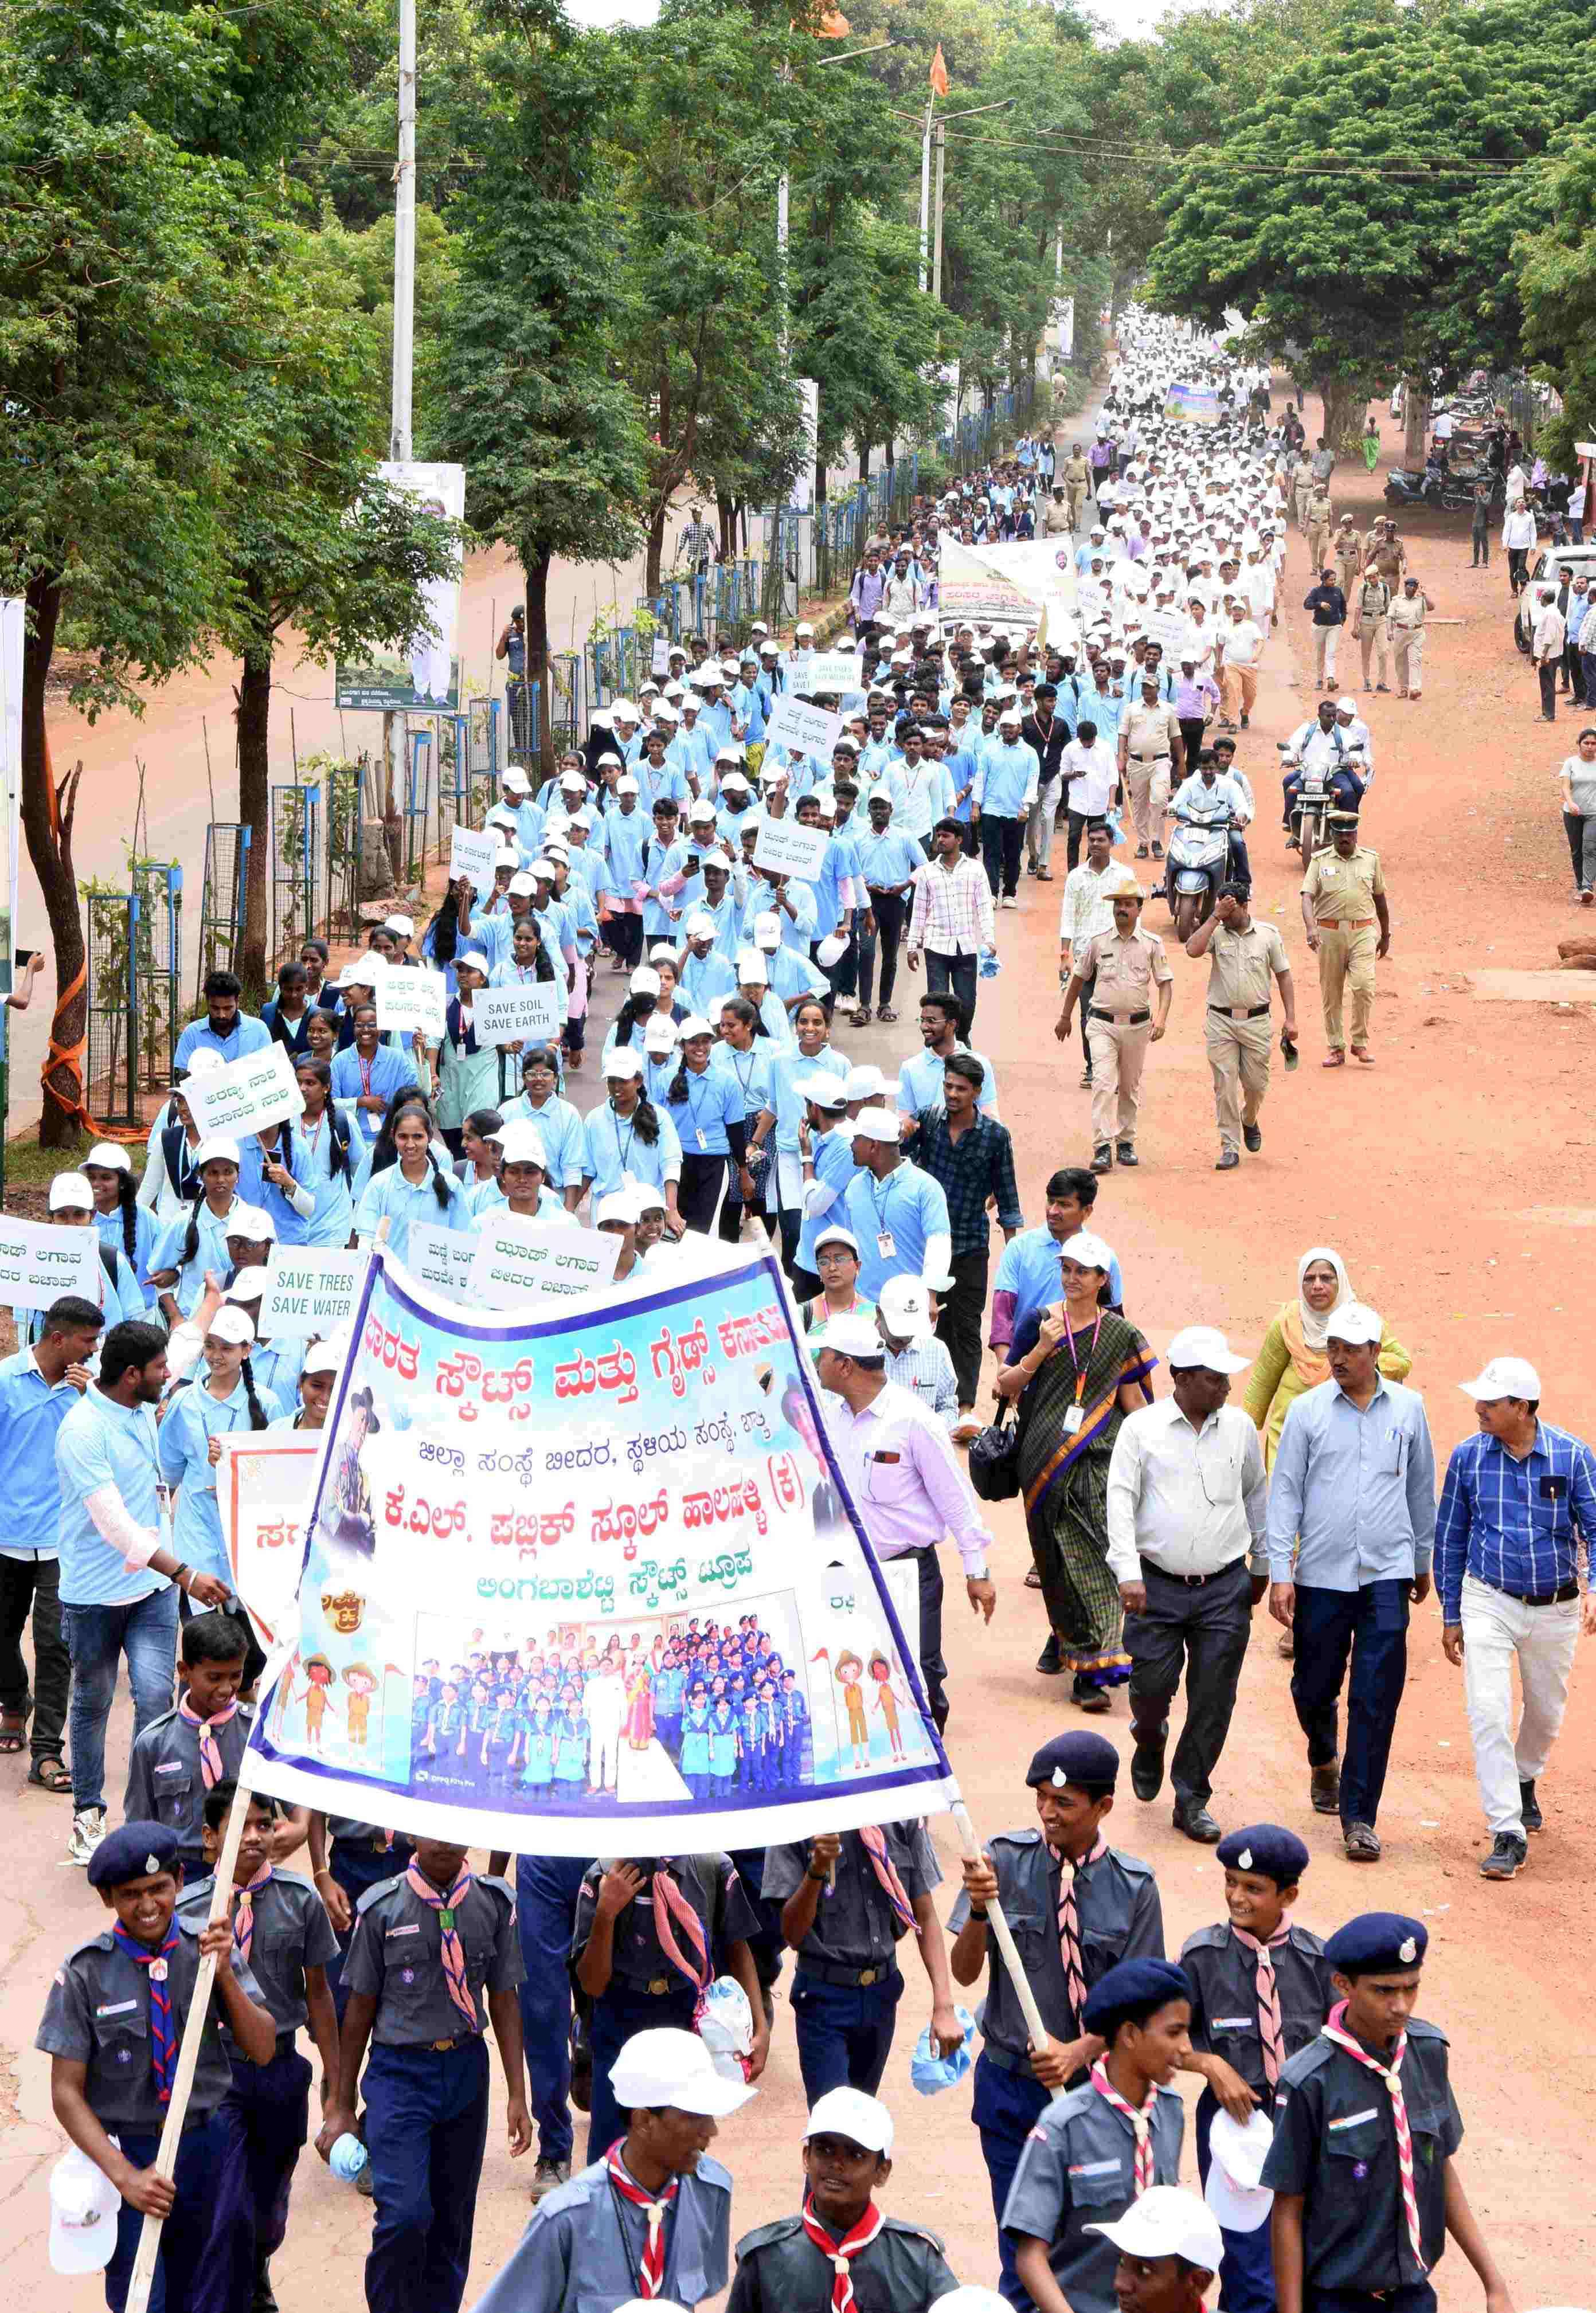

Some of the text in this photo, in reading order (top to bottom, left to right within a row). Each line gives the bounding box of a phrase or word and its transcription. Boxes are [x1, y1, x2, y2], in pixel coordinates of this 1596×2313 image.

[488, 999, 544, 1015] SAVE SOIL
[484, 1013, 550, 1030] SAVE EARTH
[277, 1271, 354, 1291] SAVE TREES
[272, 1296, 351, 1316] SAVE WATER
[554, 1338, 640, 1404] ಮತ್ತು
[651, 1318, 717, 1398] ಗೈಡ್ಸ್
[419, 1441, 465, 1477] ಜಿಲ್ಲಾ
[545, 1438, 617, 1470] ಬೀದರ,
[490, 1501, 575, 1561] ಪಬ್ಲಿಕ್
[591, 1488, 669, 1560] ಸ್ಕೂಲ್
